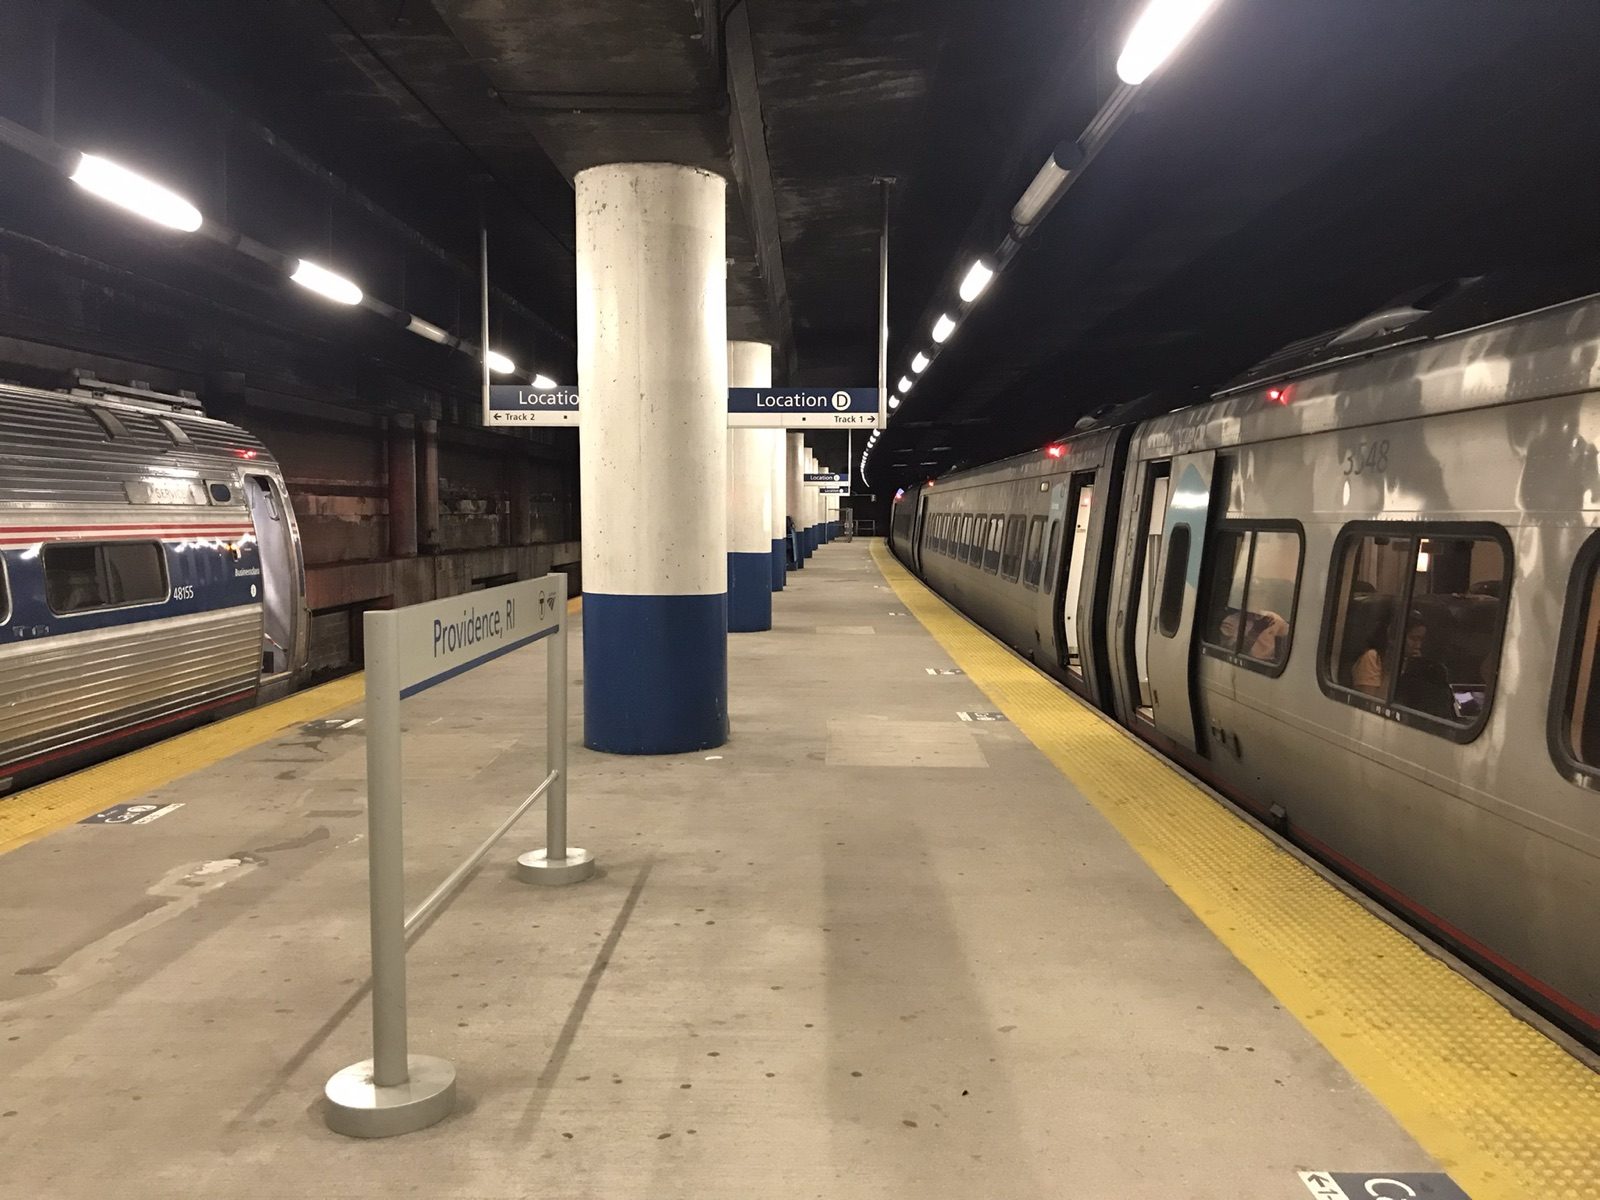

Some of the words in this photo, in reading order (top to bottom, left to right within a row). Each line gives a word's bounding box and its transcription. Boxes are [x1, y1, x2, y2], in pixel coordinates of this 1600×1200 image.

[519, 390, 579, 405] Locatio
[756, 392, 827, 407] Location
[836, 393, 848, 407] D
[505, 413, 528, 421] Track
[834, 415, 856, 423] Track
[1343, 439, 1390, 476] 3548
[173, 585, 194, 601] 48155
[433, 607, 503, 658] Providence,
[506, 598, 516, 631] RI
